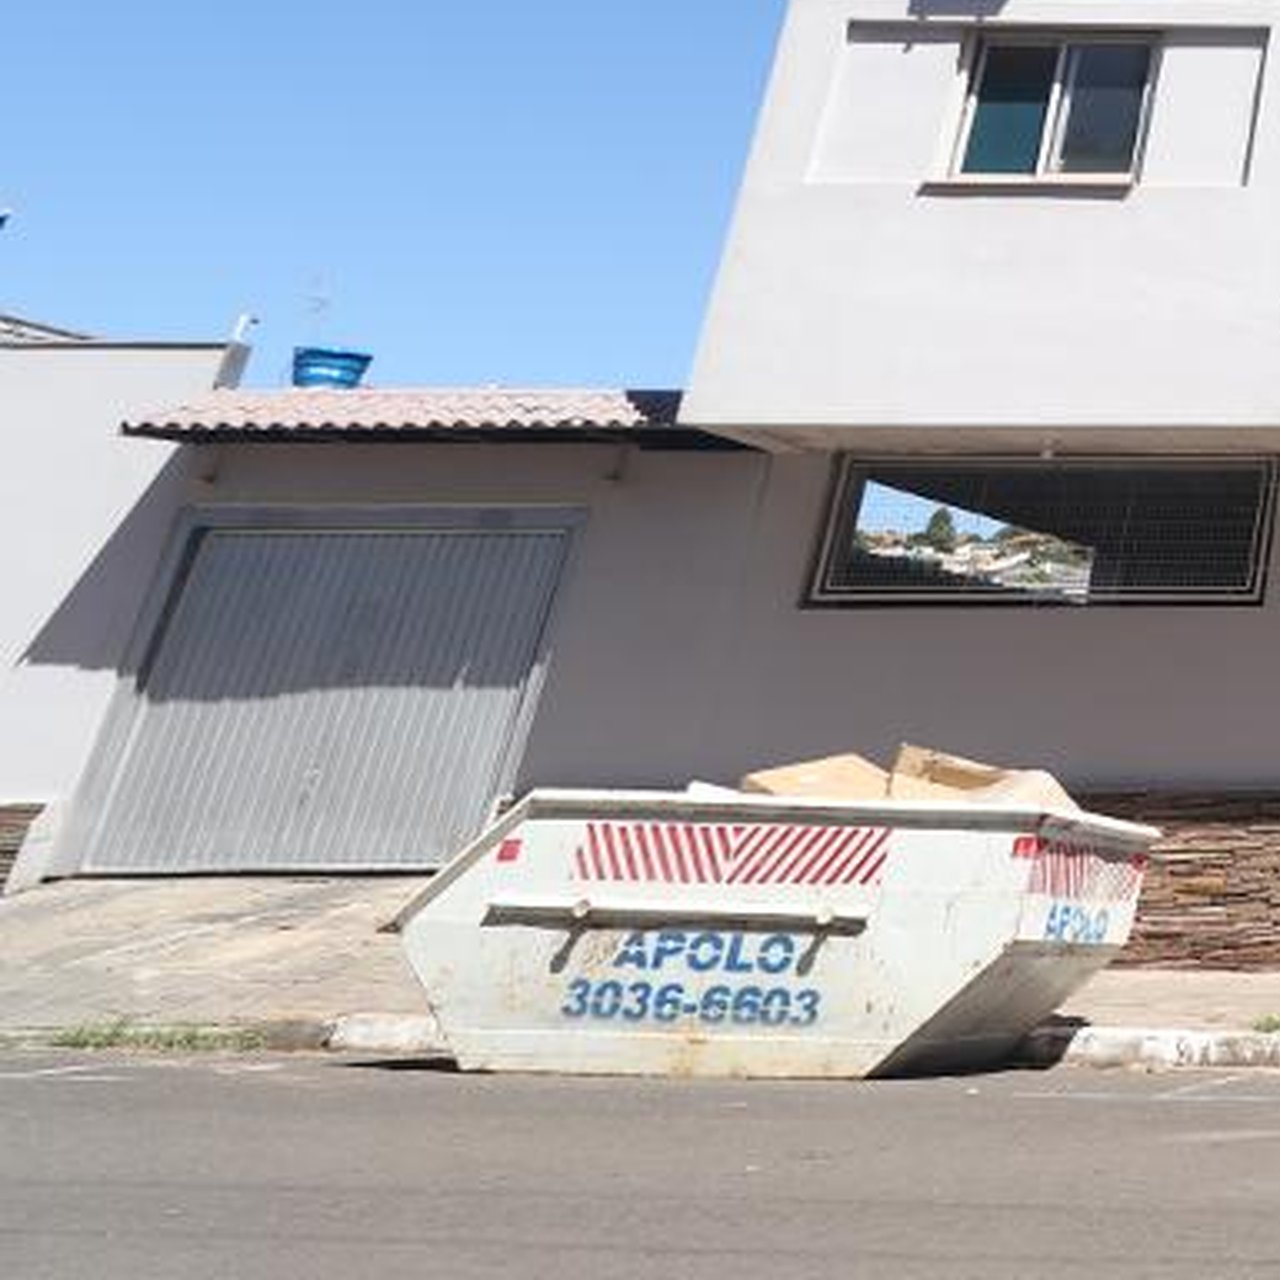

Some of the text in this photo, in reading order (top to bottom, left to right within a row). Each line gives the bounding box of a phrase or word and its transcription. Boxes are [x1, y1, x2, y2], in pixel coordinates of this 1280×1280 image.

[1044, 904, 1109, 942] APOLO
[613, 930, 795, 972] APOLO
[561, 978, 820, 1025] 3036-6603
